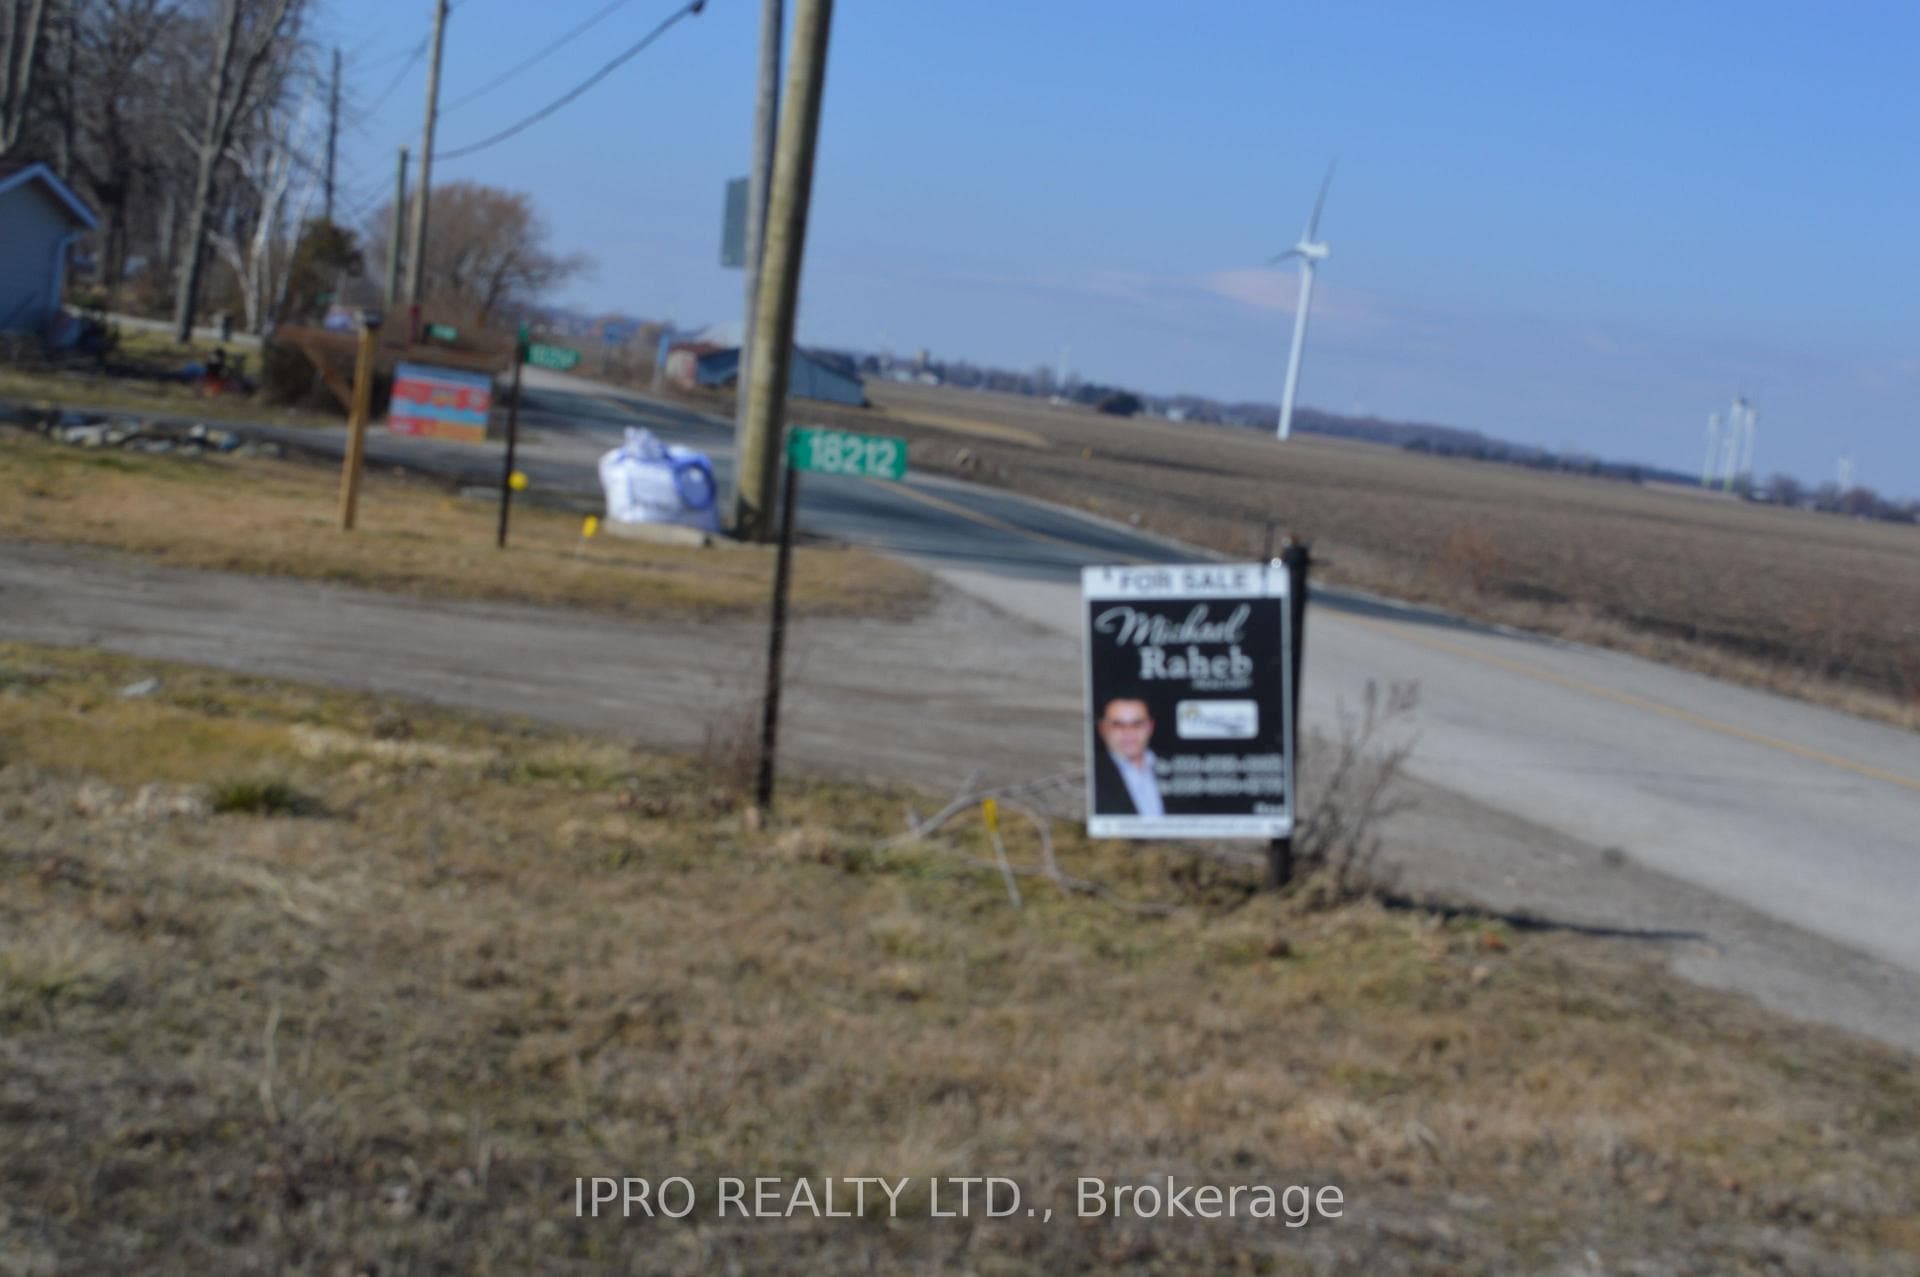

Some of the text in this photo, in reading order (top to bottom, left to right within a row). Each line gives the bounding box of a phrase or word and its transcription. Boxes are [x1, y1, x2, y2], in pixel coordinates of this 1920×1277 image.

[810, 434, 898, 477] 18212
[1119, 569, 1247, 592] FOR SALE
